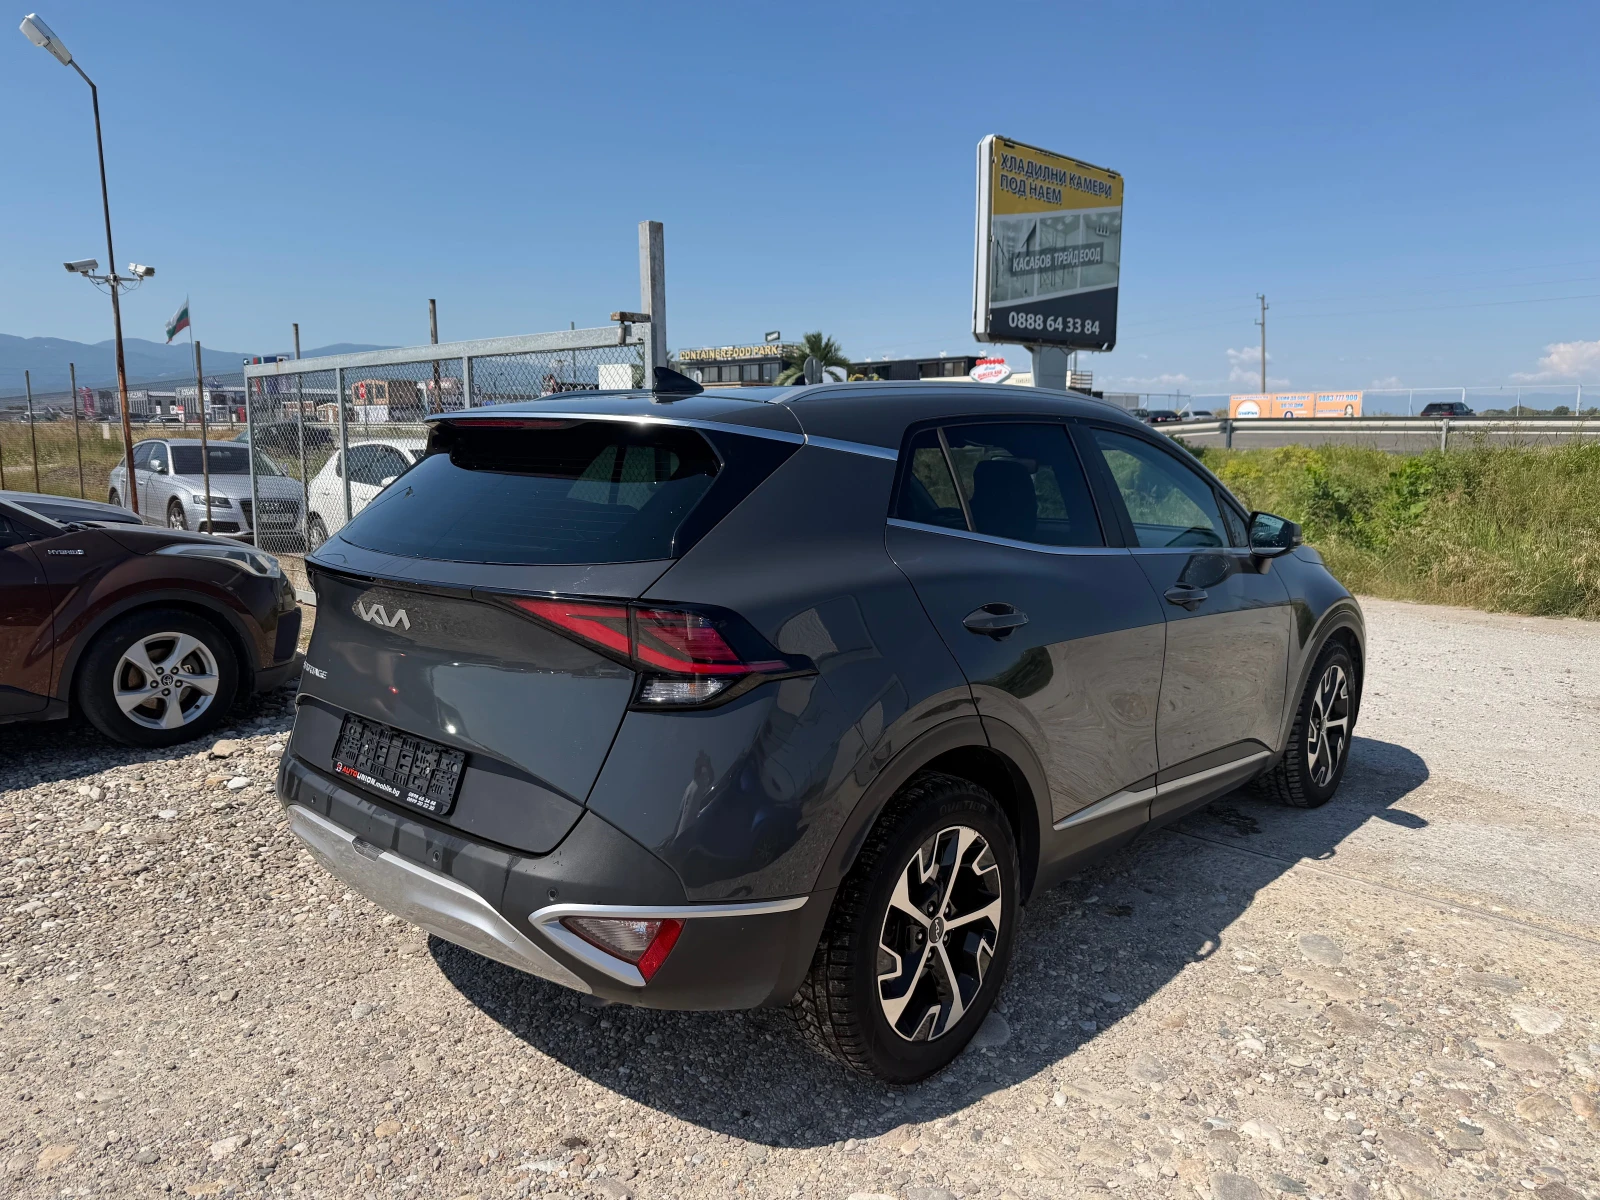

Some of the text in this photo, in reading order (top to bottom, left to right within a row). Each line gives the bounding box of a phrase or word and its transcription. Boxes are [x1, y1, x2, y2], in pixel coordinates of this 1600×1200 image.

[1000, 152, 1113, 198] ХЛАДИЛНИ КАМЕРИ
[1000, 173, 1063, 205] ПОД НАЕМ
[1012, 247, 1101, 272] КАСАБОВ ТРЕЙД ЕООД
[1008, 311, 1100, 335] 0888 64 33 84
[680, 345, 778, 360] CONTAINER FOOD PARK
[359, 600, 411, 631] KIA
